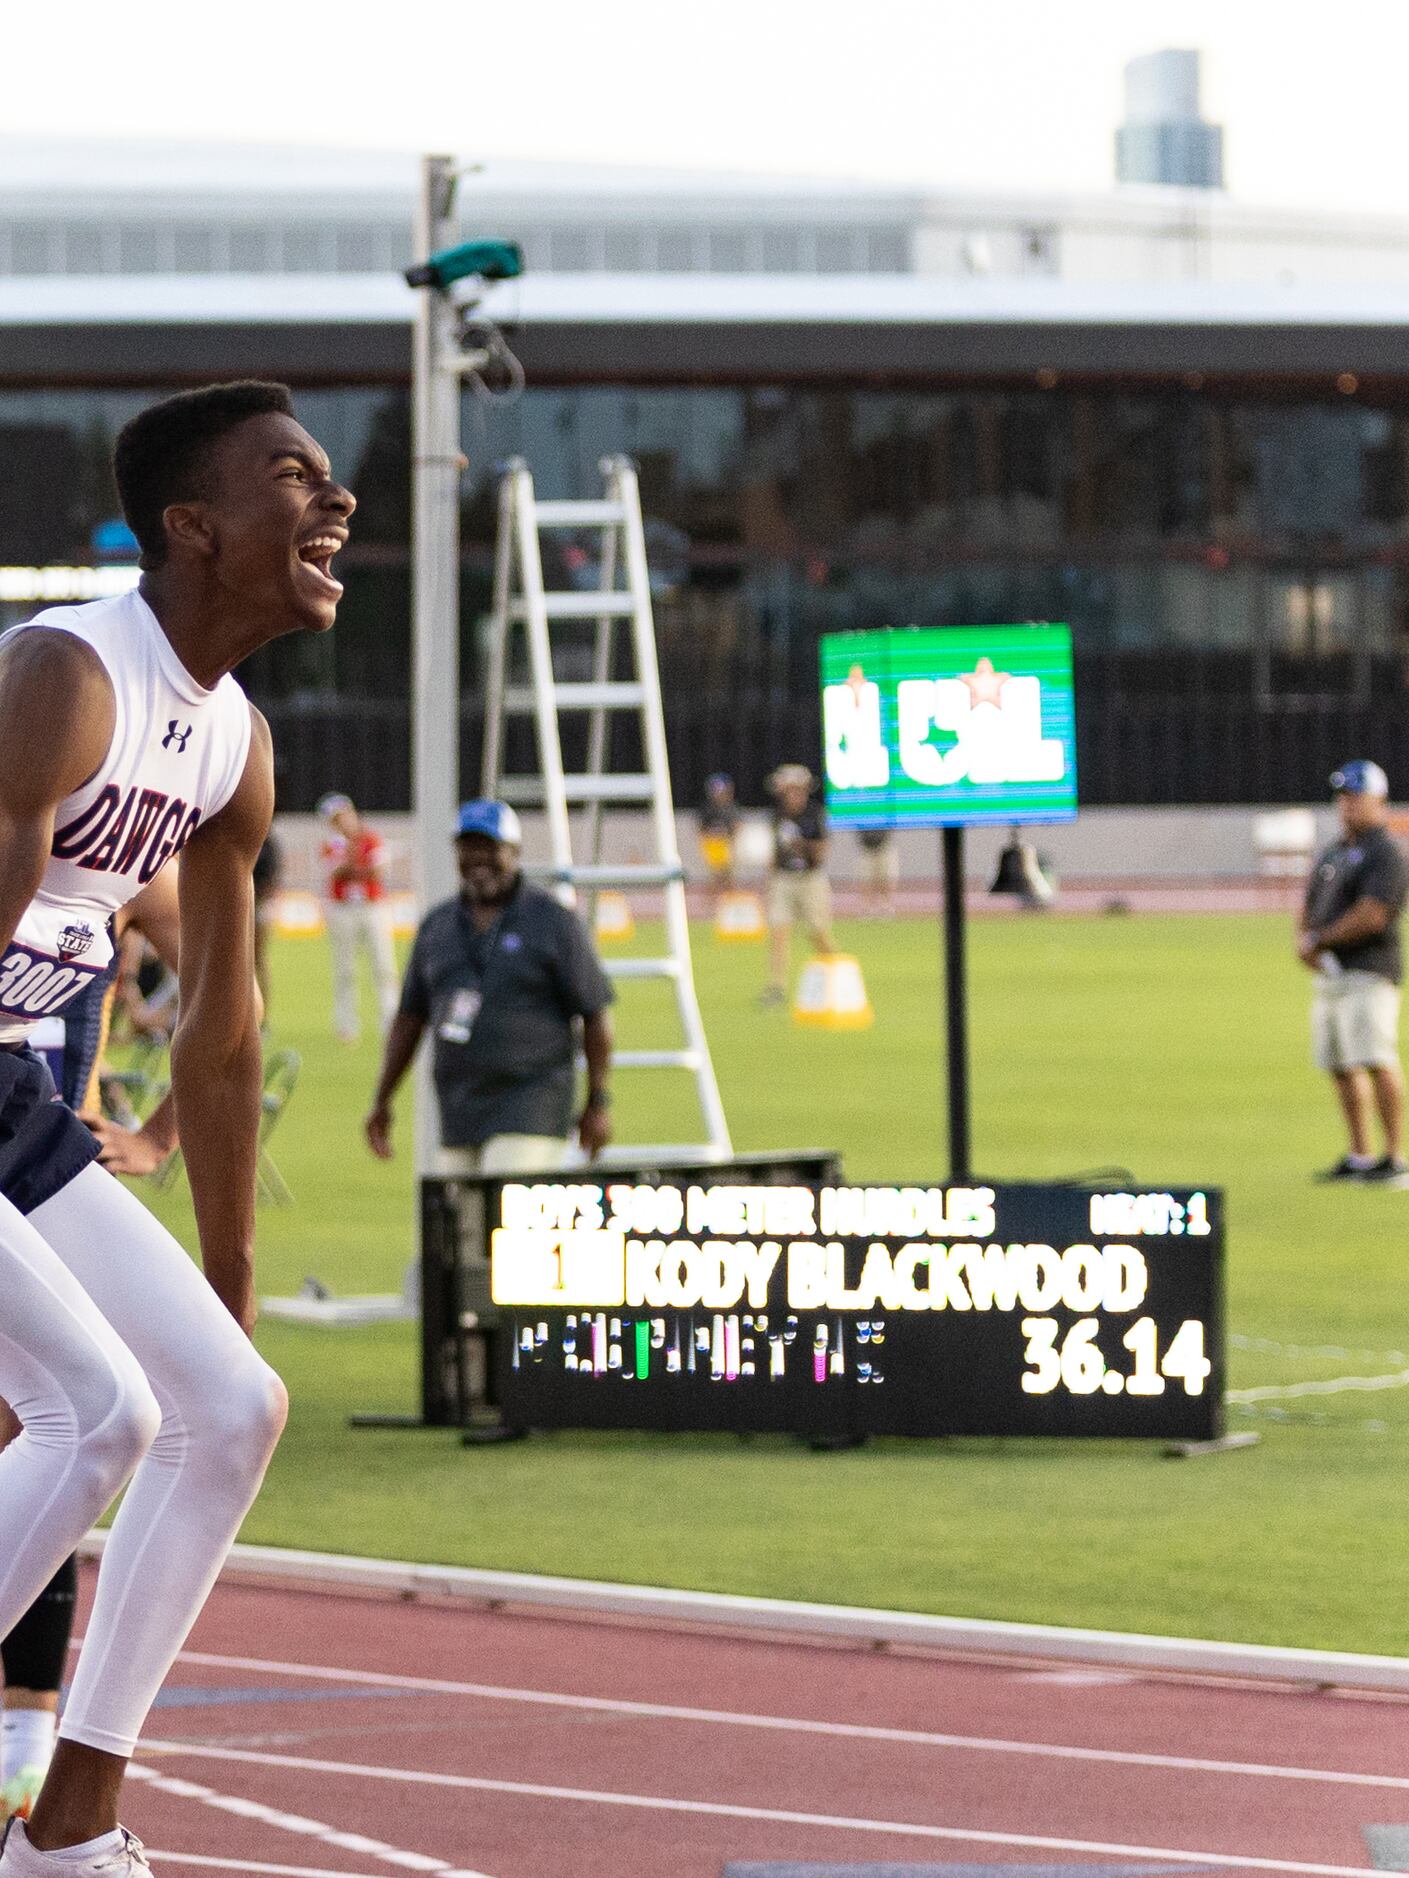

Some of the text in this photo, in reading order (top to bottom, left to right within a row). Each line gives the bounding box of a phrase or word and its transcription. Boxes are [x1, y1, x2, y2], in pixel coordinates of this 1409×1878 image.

[501, 1184, 995, 1237] BOYS 300 METER HURDLES
[626, 1240, 782, 1308] KODY
[788, 1242, 1148, 1312] BLACKWOOD
[1021, 1317, 1211, 1395] 36.14
